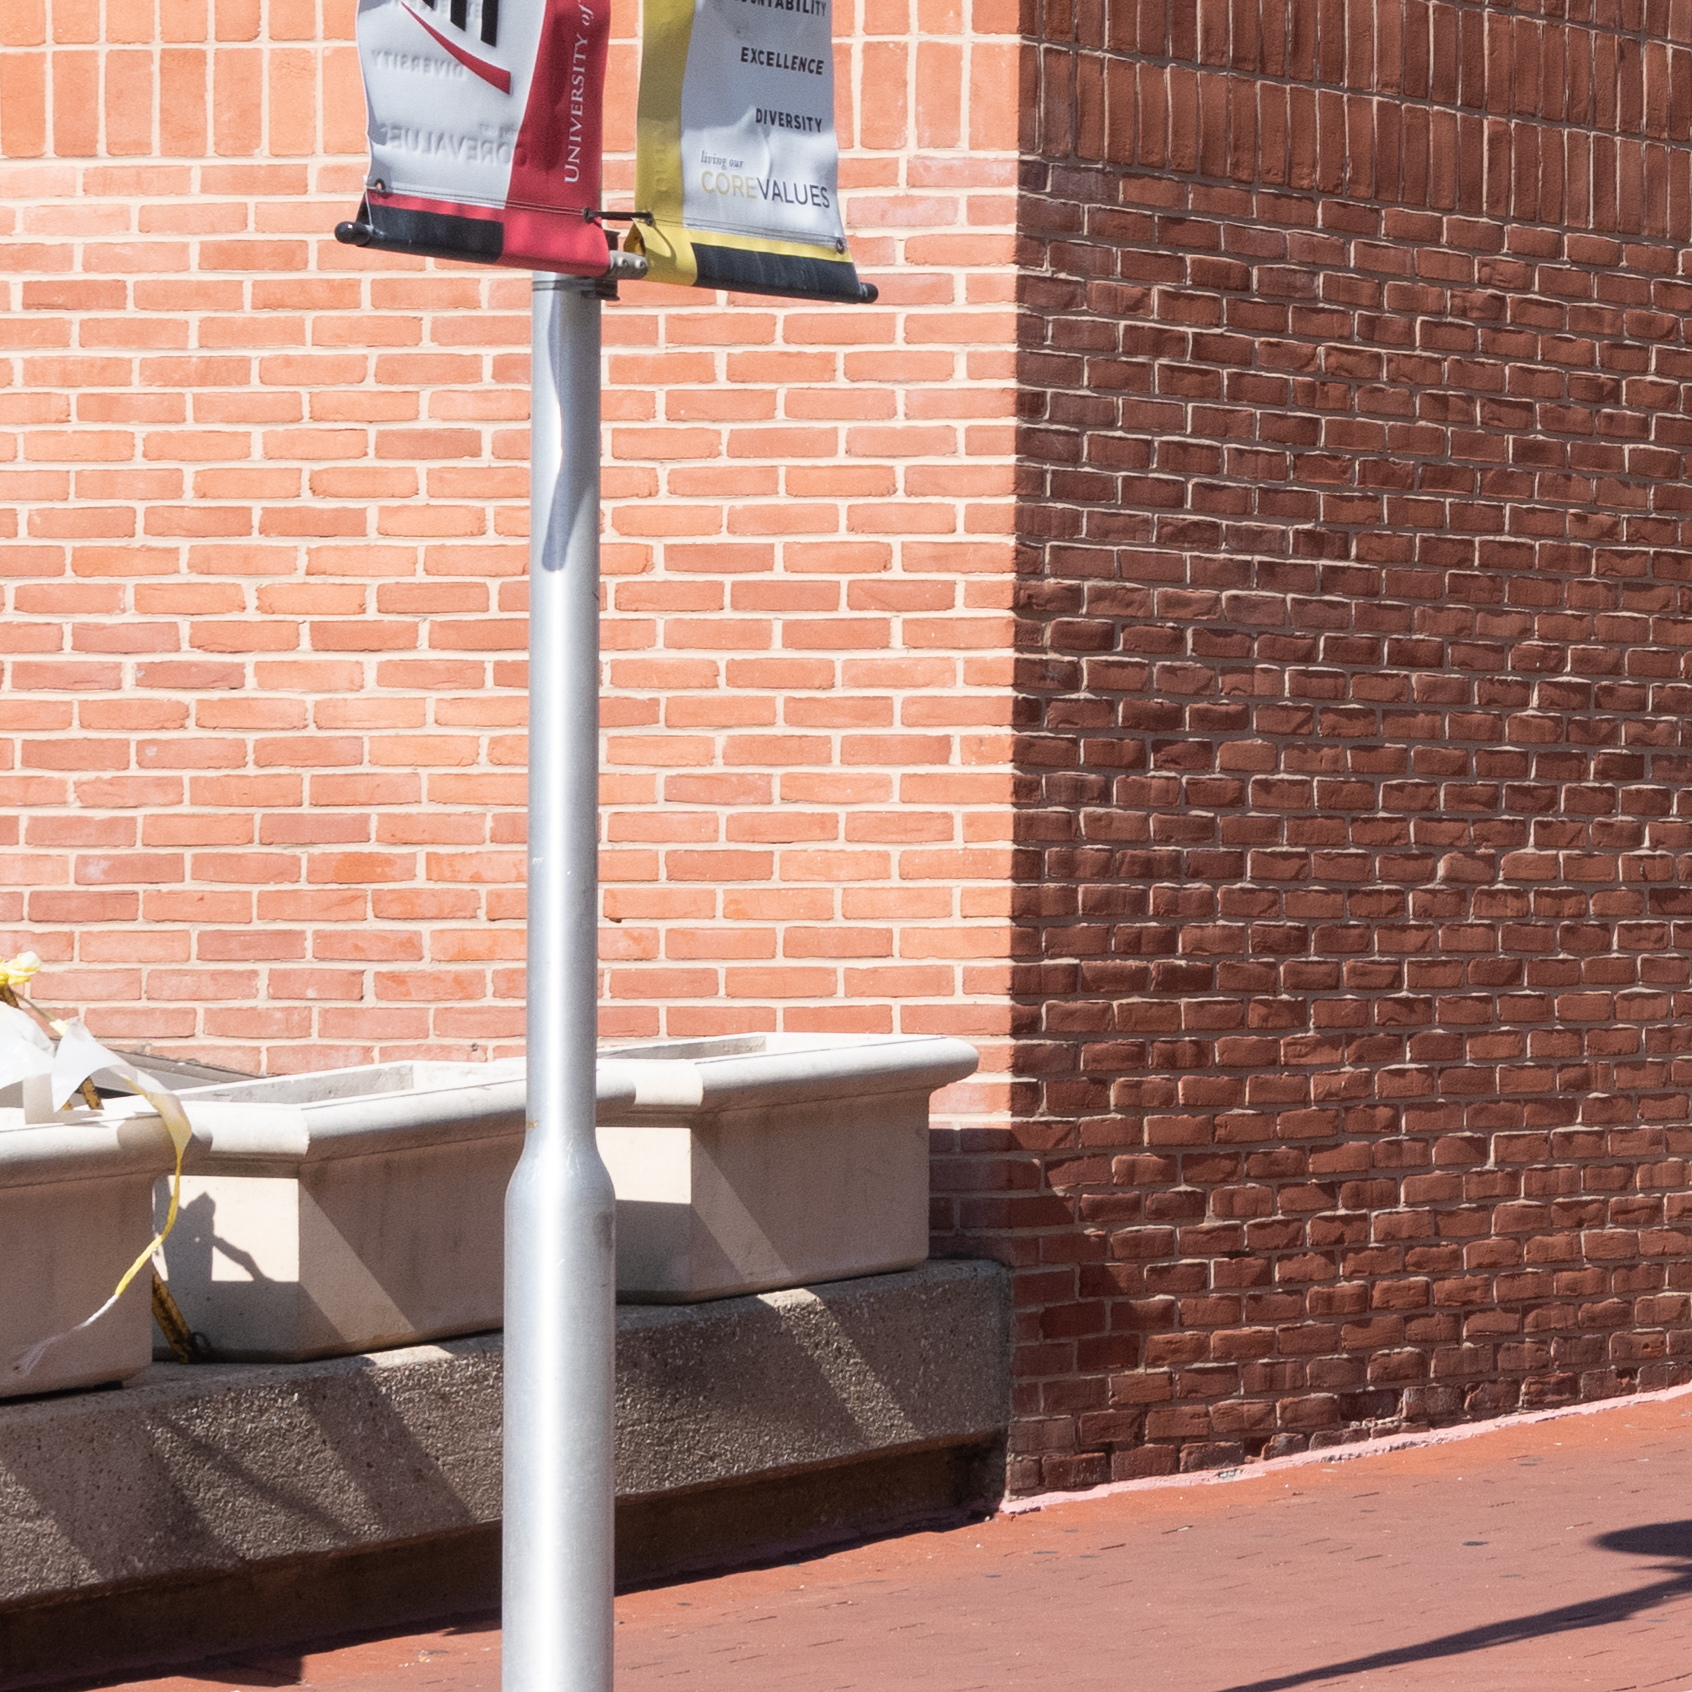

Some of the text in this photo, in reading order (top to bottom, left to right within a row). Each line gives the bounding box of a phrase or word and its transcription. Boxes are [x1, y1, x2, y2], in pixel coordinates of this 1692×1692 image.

[740, 46, 824, 75] EXCELLENCE
[564, 33, 588, 183] UNIVERSITY
[578, 0, 594, 26] of
[755, 108, 823, 133] DIVERSITY
[700, 150, 744, 170] living our
